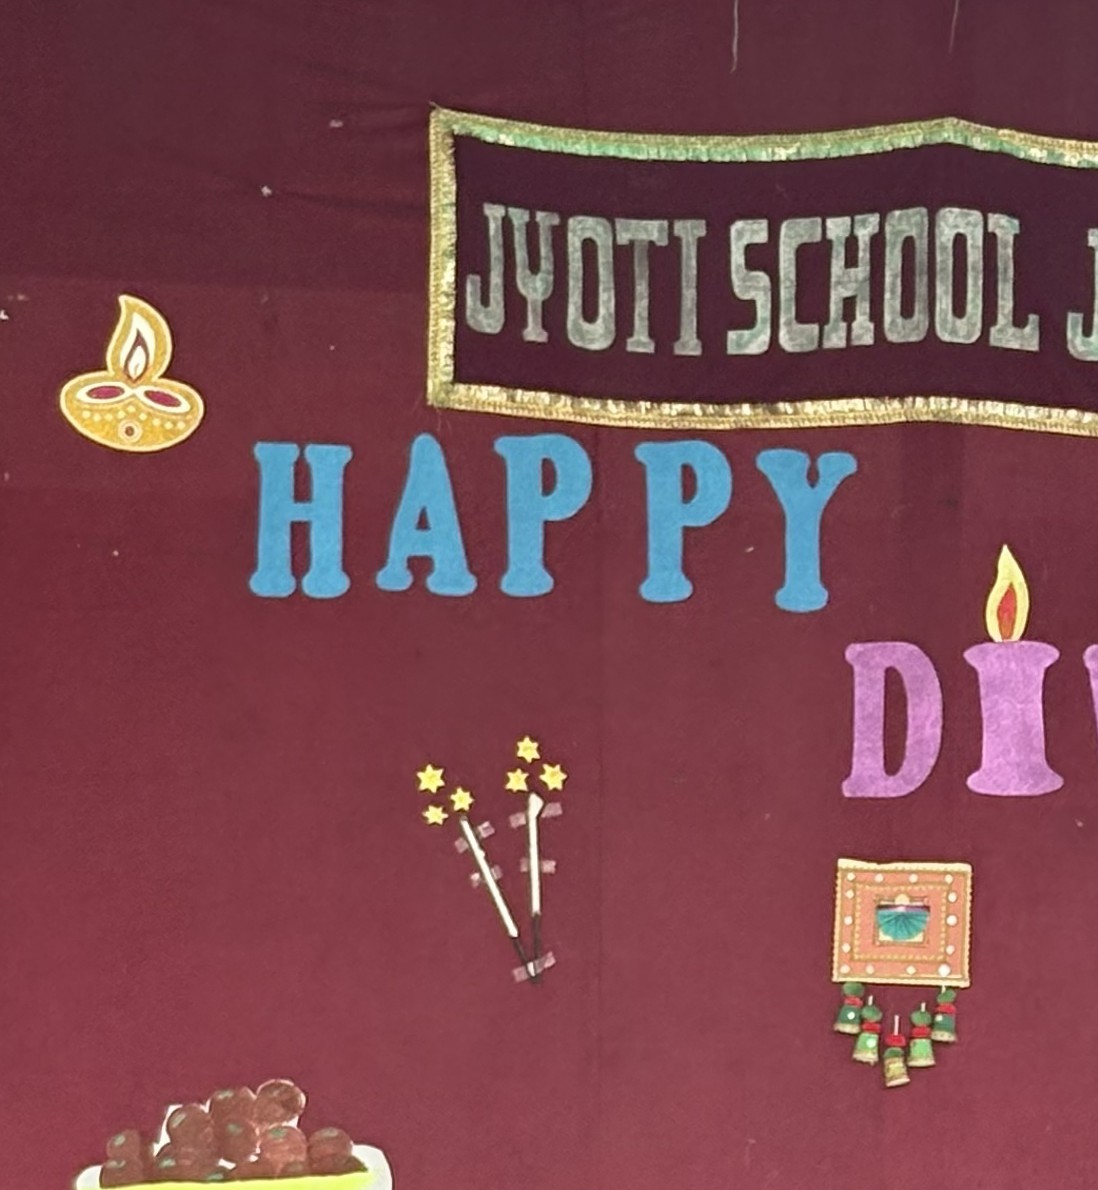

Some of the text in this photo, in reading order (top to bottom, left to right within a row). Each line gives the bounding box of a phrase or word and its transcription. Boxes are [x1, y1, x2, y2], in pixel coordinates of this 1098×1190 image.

[465, 203, 707, 356] JYOTI
[726, 206, 1040, 356] SCHOOL
[249, 433, 857, 612] HAPPY
